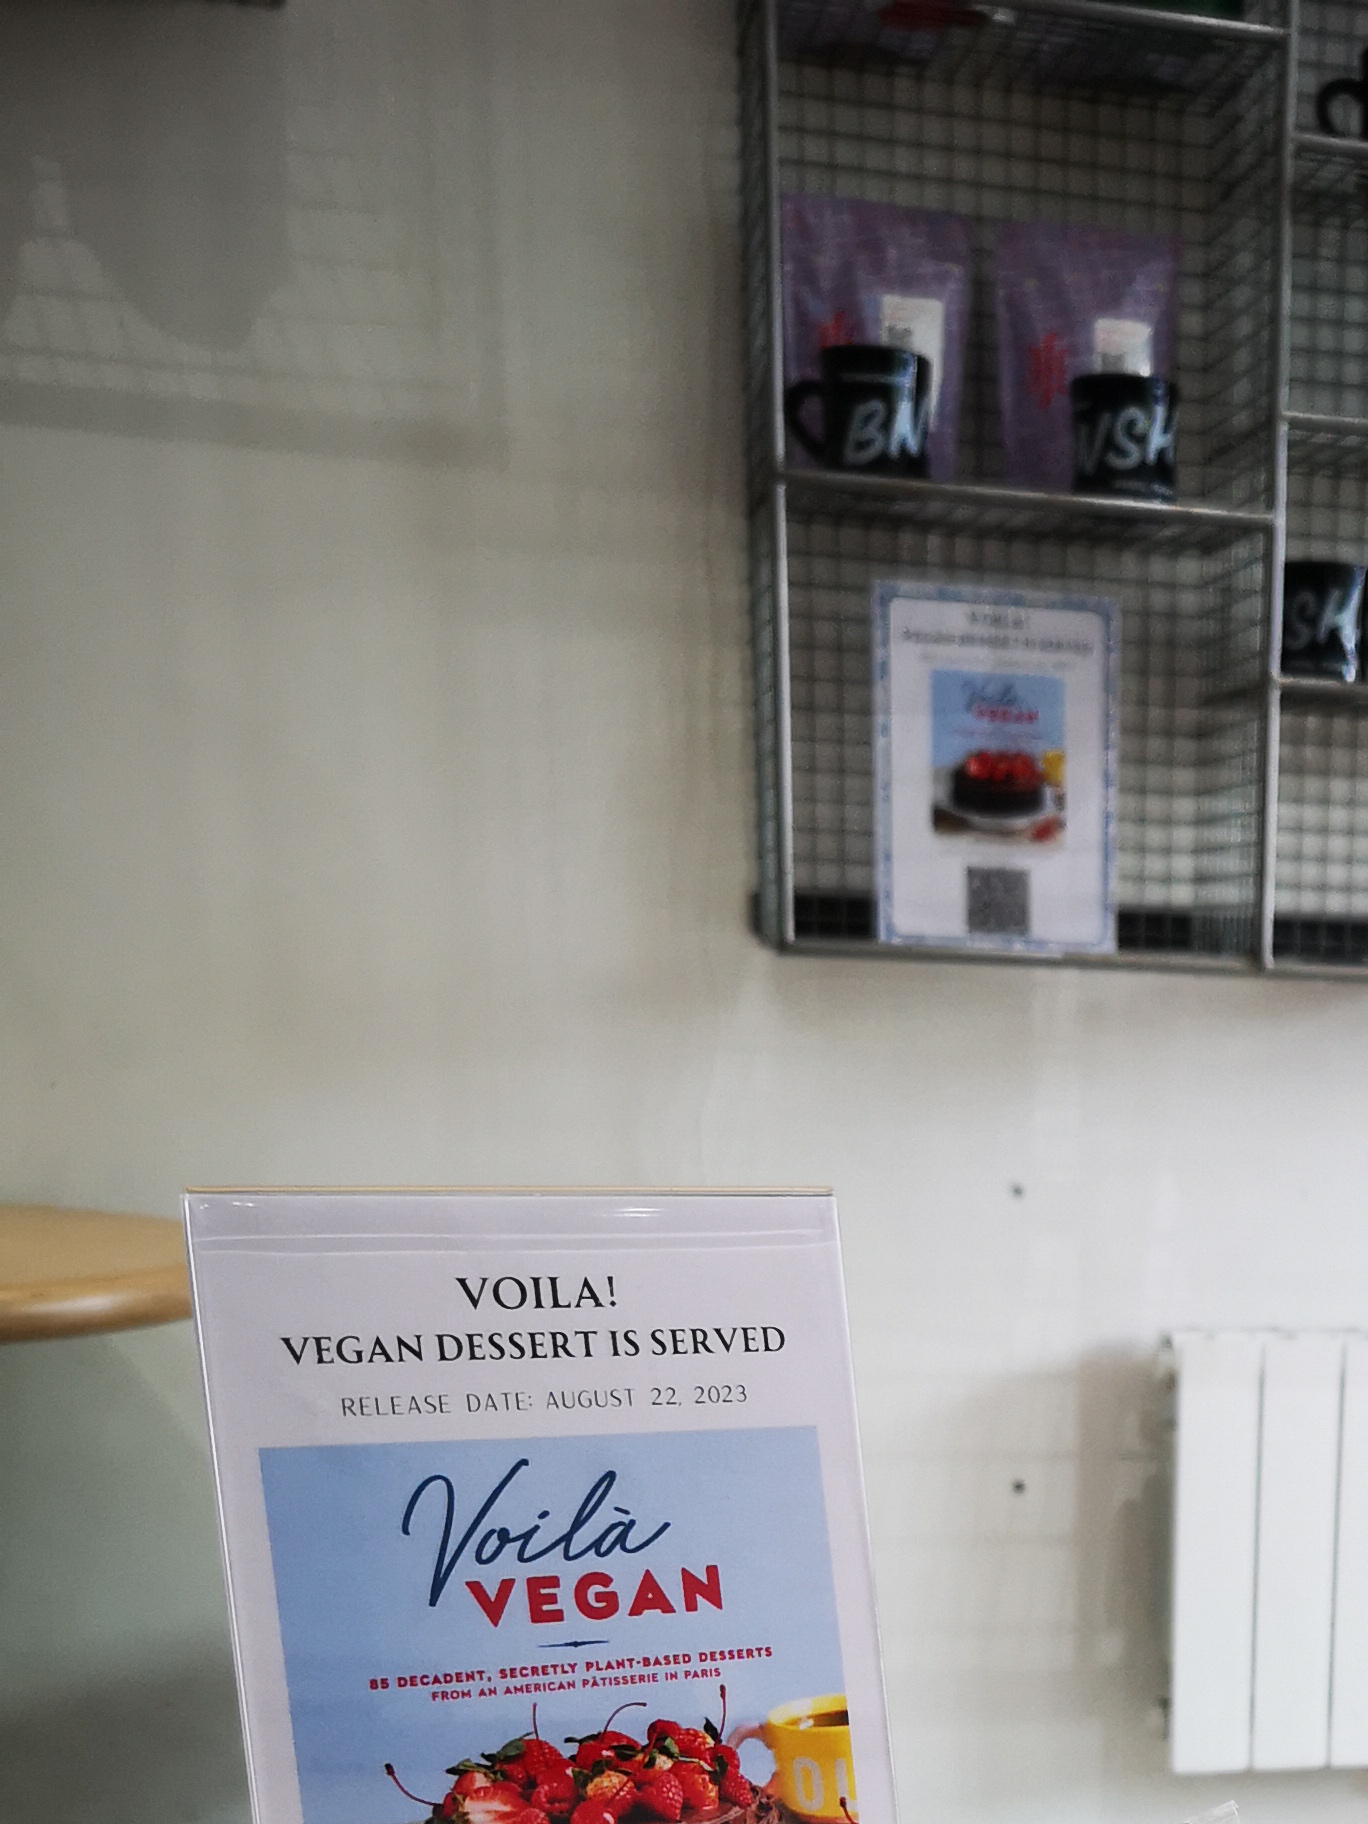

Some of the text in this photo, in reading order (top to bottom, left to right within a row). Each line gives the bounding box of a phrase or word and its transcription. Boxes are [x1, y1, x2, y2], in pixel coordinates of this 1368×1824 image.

[455, 1275, 617, 1310] VOILA!
[280, 1326, 786, 1365] VEGAN DESSERT IS SERVED
[341, 1384, 747, 1418] RELEASE DATE: AUGUST 22, 2023
[402, 1458, 671, 1608] Voilà
[465, 1565, 722, 1626] VEGAN
[369, 1646, 773, 1691] 85 DECADENT, SECRETLY PLANT-BASED DESSERTS
[431, 1667, 721, 1702] FROM AN AMERICAN PÂTISSERIE IN PARIS
